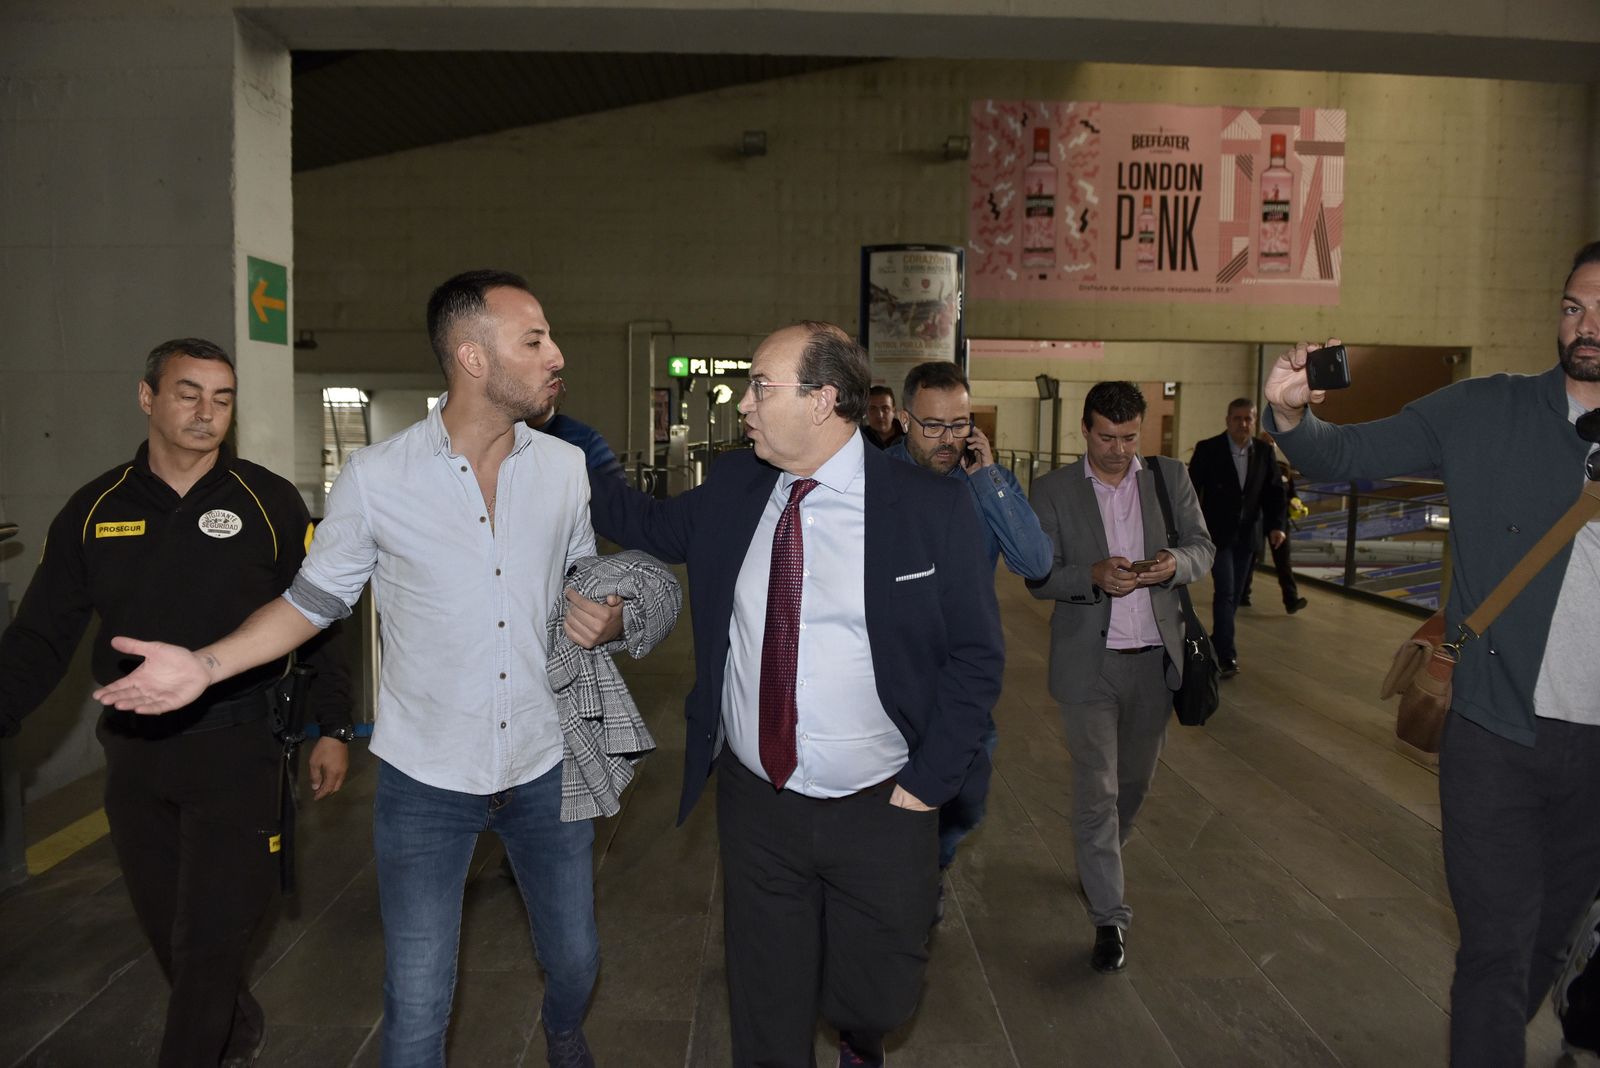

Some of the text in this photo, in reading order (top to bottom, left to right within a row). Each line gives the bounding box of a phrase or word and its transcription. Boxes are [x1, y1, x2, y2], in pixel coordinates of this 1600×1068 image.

[1131, 134, 1189, 151] BEEFEATER
[1117, 161, 1203, 191] LONDON
[690, 359, 708, 374] P1
[99, 525, 141, 533] PROSEGUR
[202, 522, 239, 530] SEGURIDAD
